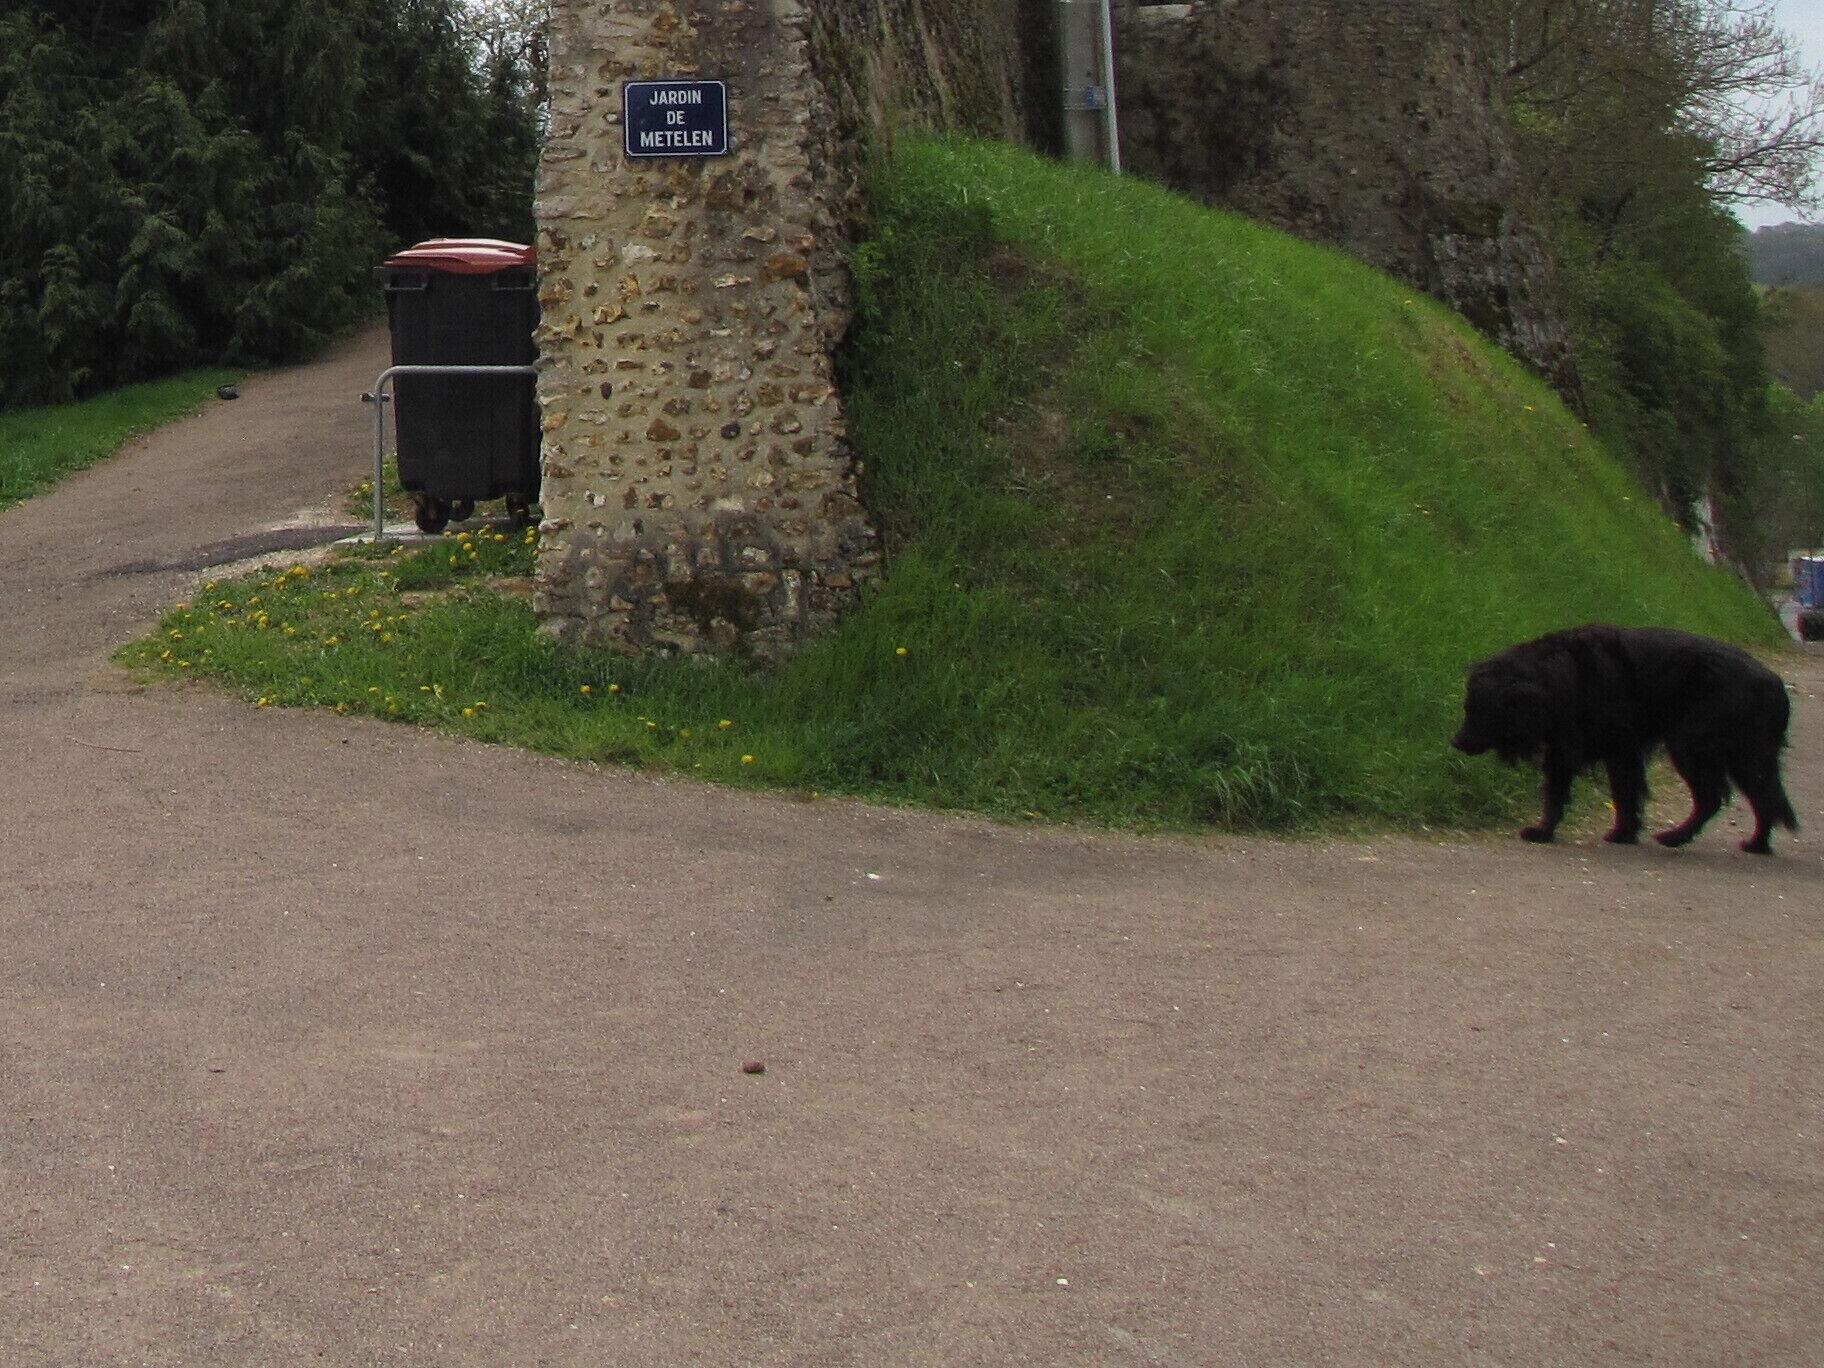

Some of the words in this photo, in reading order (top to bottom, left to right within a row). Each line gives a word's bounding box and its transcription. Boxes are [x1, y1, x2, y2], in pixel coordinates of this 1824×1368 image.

[649, 90, 702, 105] JARDIN
[666, 110, 685, 125] DE
[640, 130, 713, 147] METELEN
